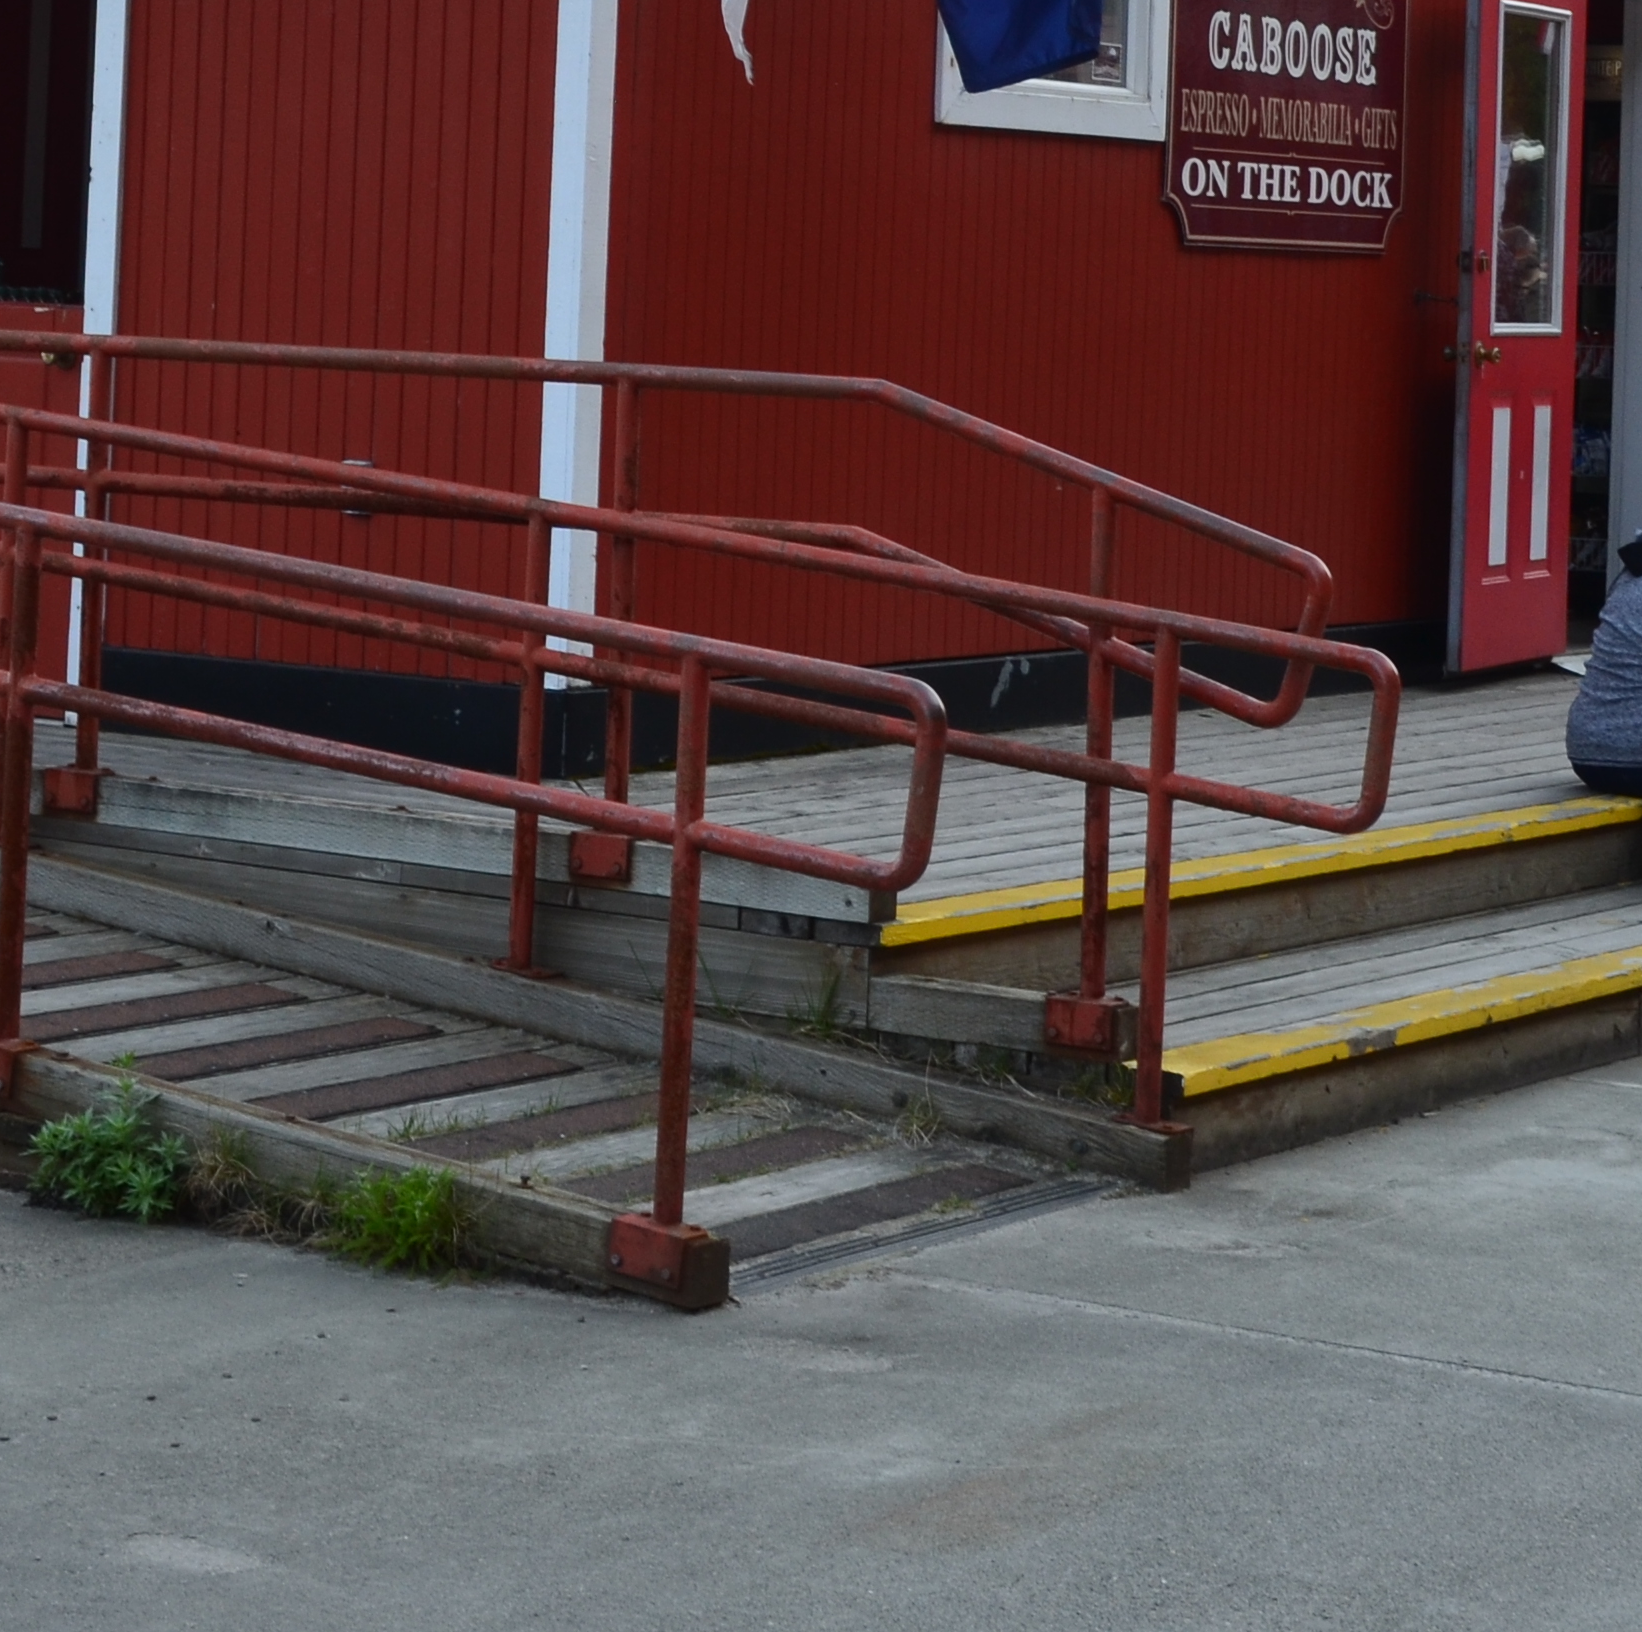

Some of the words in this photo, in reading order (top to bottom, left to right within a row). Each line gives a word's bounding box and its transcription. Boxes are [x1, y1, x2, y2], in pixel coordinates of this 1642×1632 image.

[1208, 9, 1377, 86] CABOOSE
[1180, 88, 1250, 138] ESPRESSO
[1259, 96, 1354, 147] MEMORABILIA
[1361, 106, 1398, 151] GIFTS
[1181, 156, 1231, 199] ON
[1237, 161, 1301, 203] THE
[1307, 167, 1394, 209] DOCK
